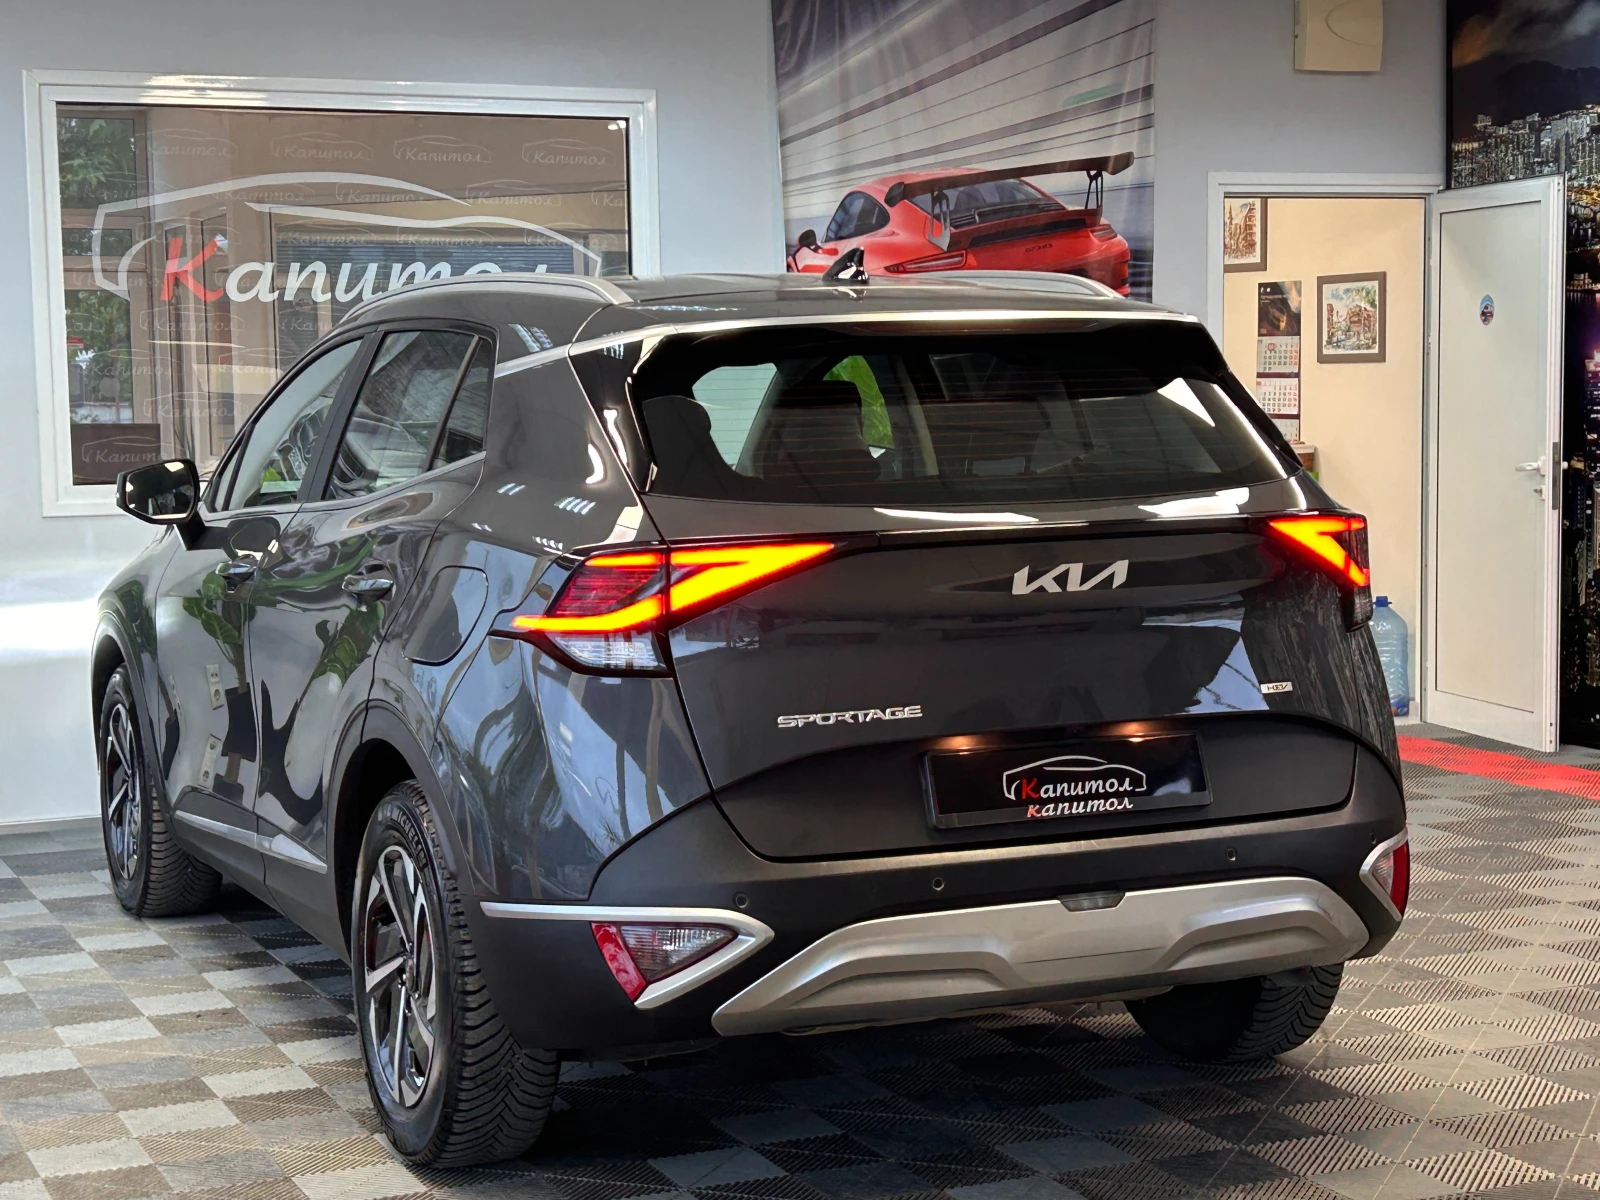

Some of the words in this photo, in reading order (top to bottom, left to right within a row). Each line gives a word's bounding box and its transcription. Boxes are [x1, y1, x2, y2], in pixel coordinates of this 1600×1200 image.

[284, 145, 365, 160] Капитол
[405, 147, 482, 163] Капитол
[533, 150, 607, 165] Капитол
[1012, 560, 1129, 595] KIA
[1266, 683, 1289, 692] HEV
[777, 705, 923, 728] SPORTAGE
[1021, 777, 1134, 799] Капитол
